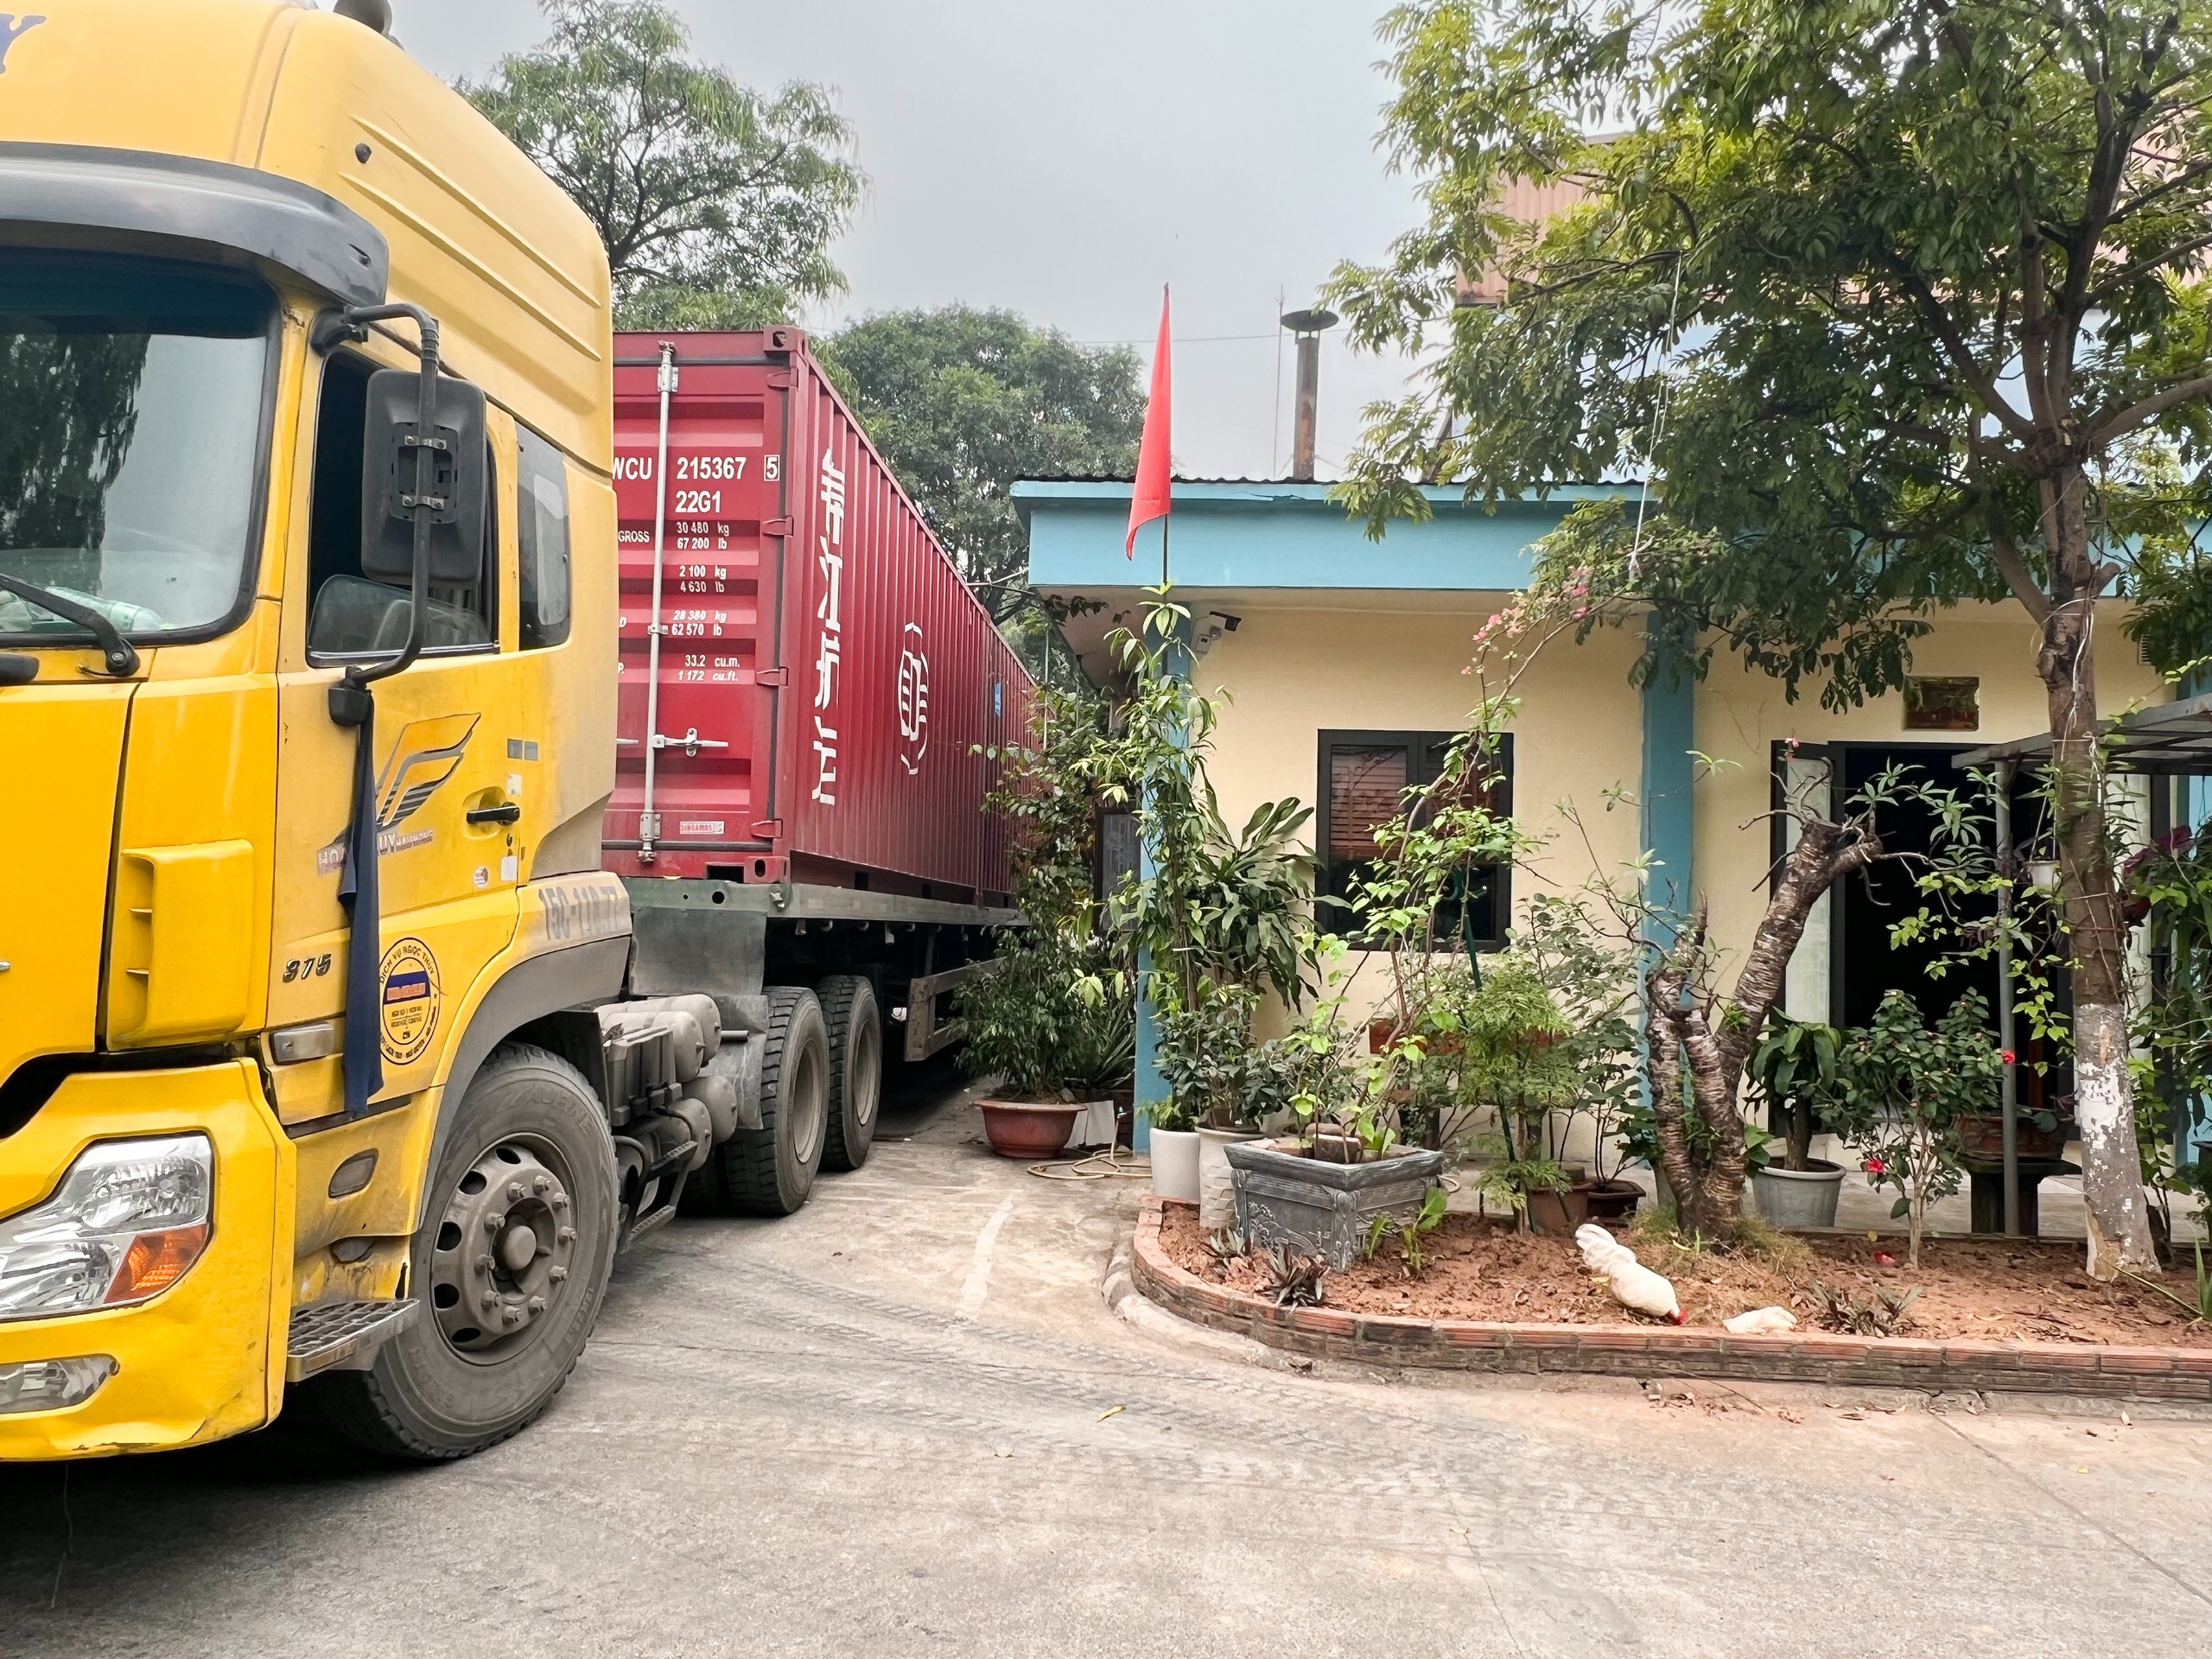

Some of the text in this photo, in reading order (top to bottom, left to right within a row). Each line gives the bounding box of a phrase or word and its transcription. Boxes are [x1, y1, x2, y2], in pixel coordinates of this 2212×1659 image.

[676, 457, 747, 480] 215367
[766, 458, 778, 480] 5
[675, 491, 721, 513] 22G1
[718, 522, 729, 537] kg
[618, 531, 650, 543] GROSS
[718, 537, 728, 550] lb
[715, 565, 727, 579] kg
[715, 582, 725, 593] lb
[715, 610, 728, 623] kg
[713, 624, 722, 636] lb
[684, 655, 741, 668] 33.2 cu.m.
